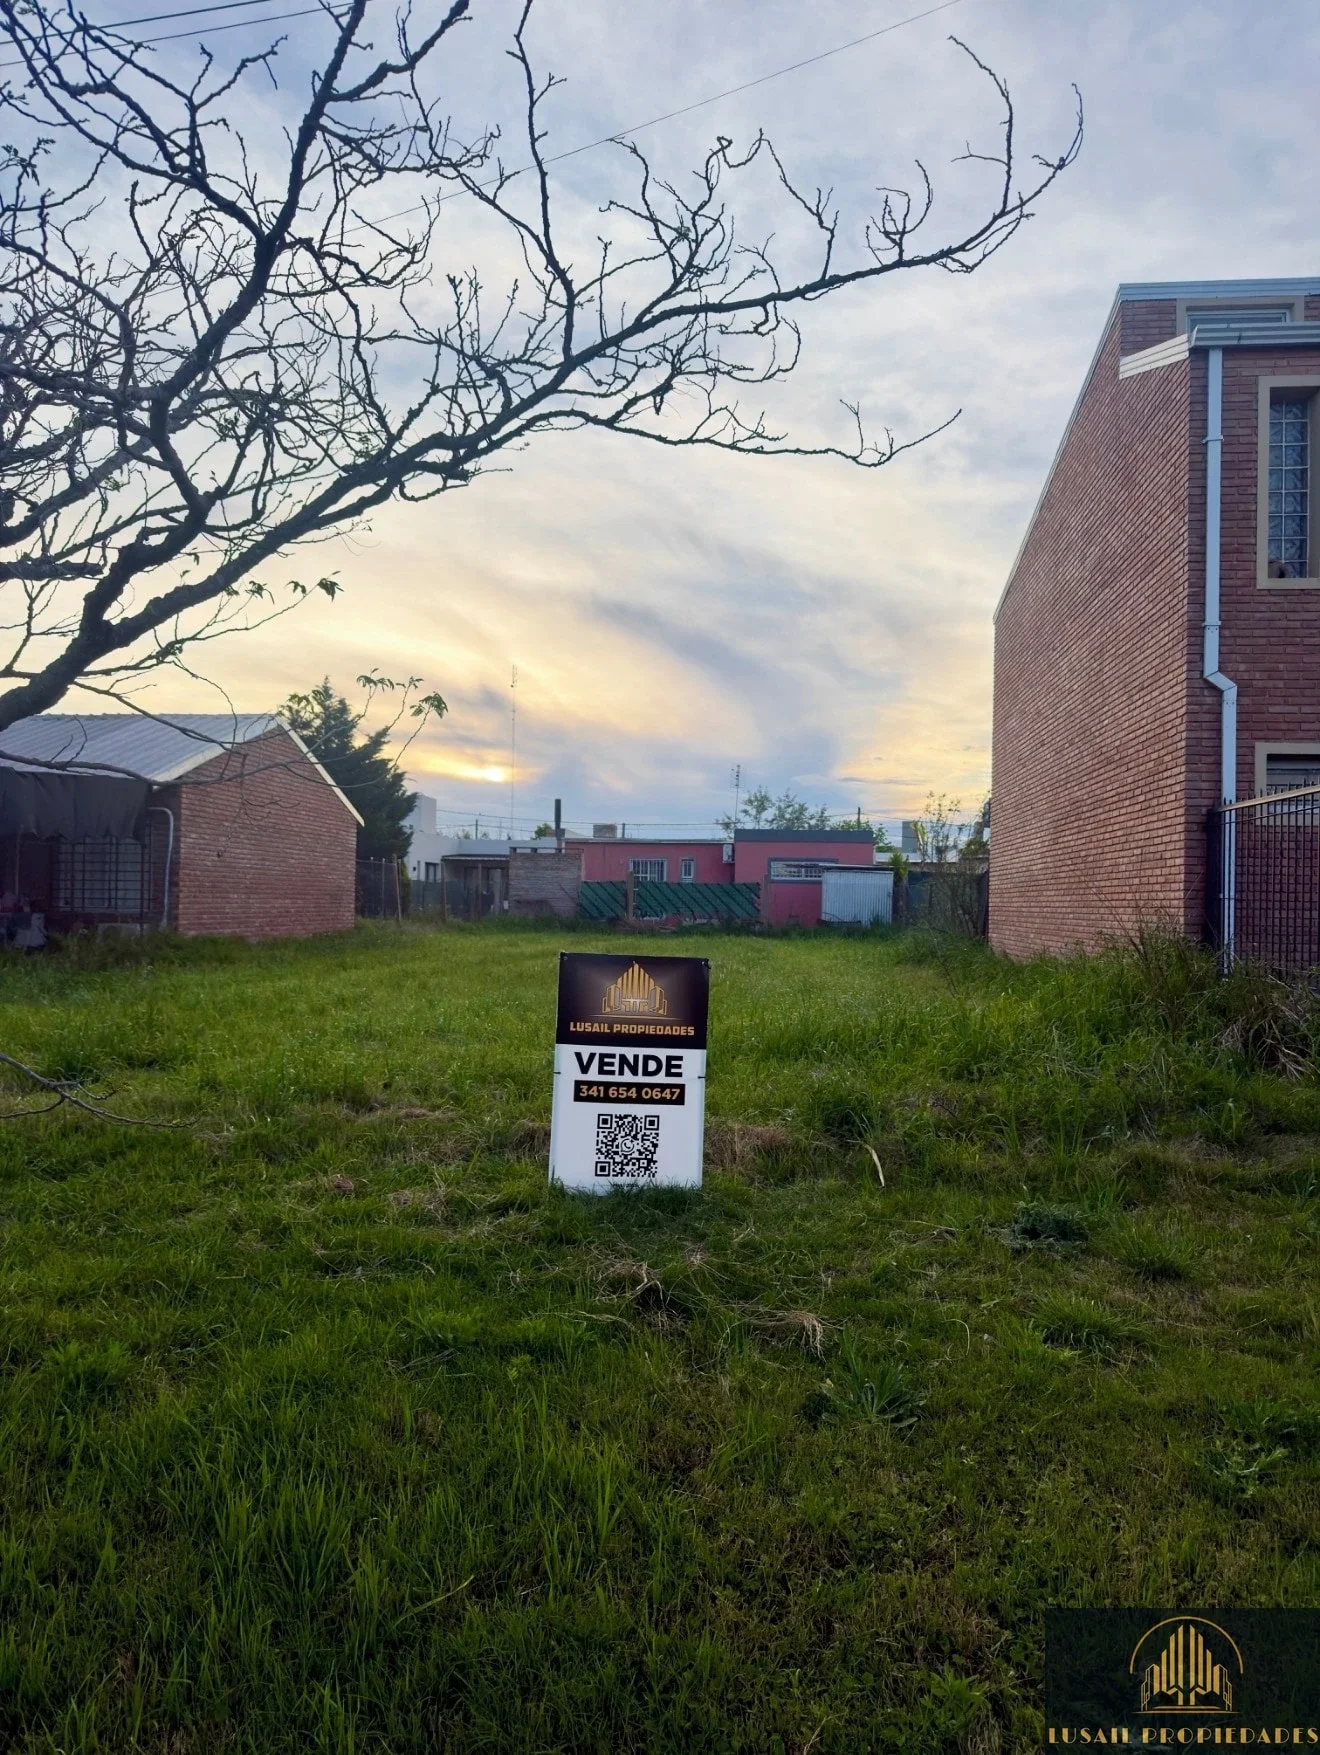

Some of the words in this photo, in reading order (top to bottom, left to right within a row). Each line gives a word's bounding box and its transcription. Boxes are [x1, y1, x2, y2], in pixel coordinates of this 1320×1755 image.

[569, 1021, 611, 1034] LUSAIL
[613, 1023, 695, 1036] PROPIEDADES
[574, 1051, 684, 1078] VENDE
[579, 1085, 604, 1098] 341
[608, 1086, 638, 1099] 654
[641, 1087, 681, 1100] 0647
